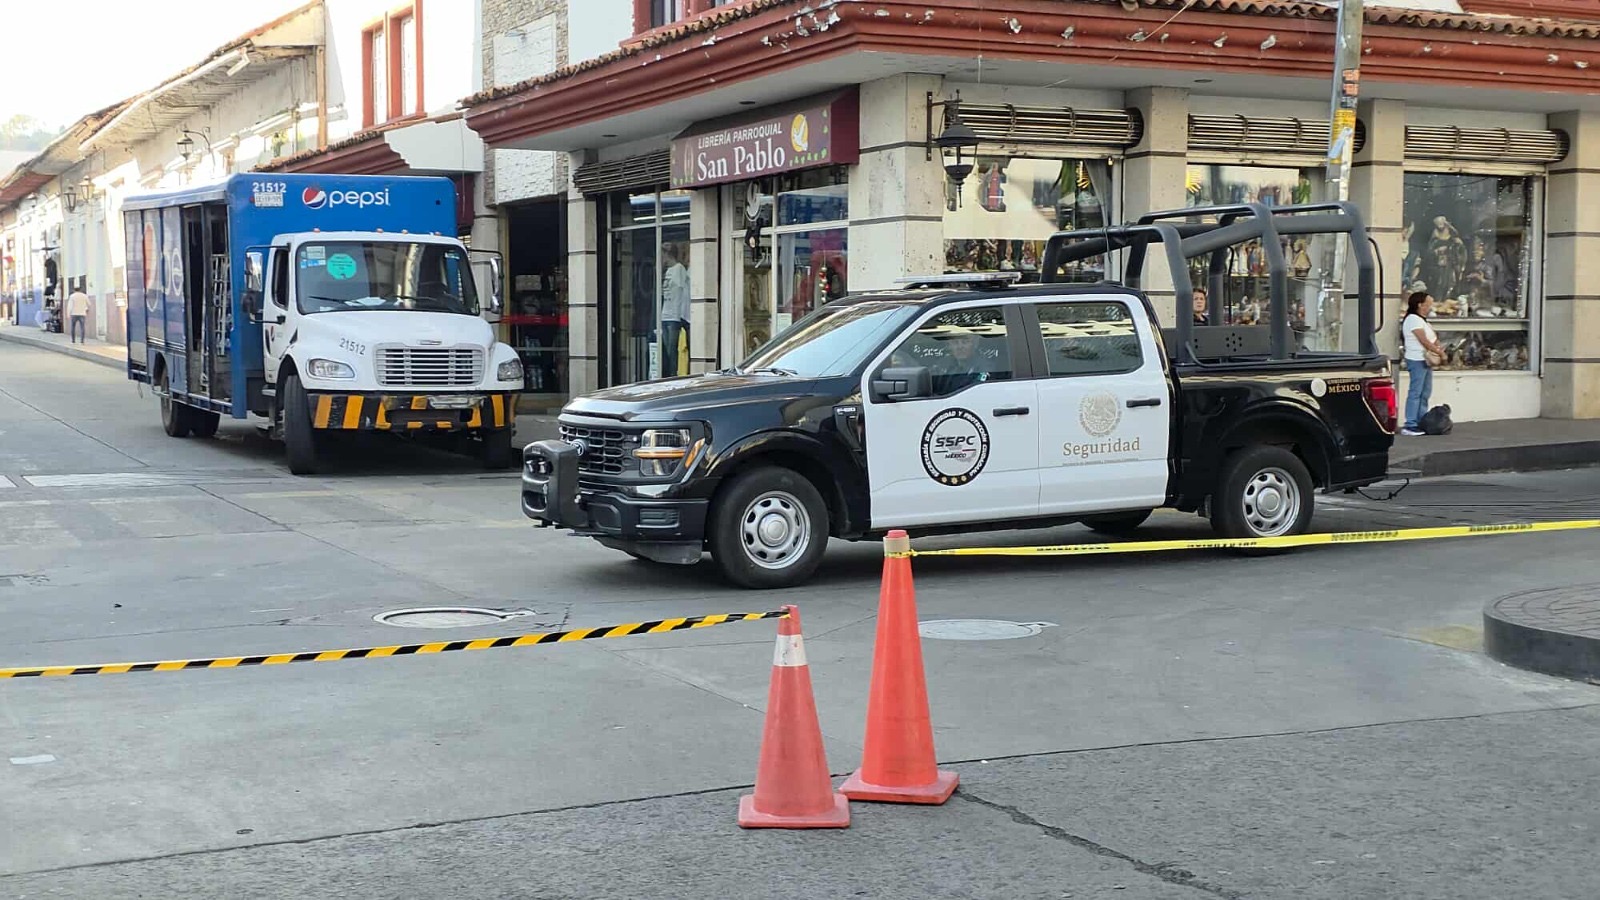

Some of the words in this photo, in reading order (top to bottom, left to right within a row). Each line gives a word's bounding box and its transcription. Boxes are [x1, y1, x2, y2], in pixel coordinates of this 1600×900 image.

[698, 132, 731, 149] LIBRERÍA
[733, 123, 782, 142] PARROQUIAL
[697, 152, 728, 181] San
[733, 138, 785, 176] Pablo
[252, 182, 287, 193] 21512
[329, 188, 390, 208] pepsi
[339, 338, 366, 355] 21512
[1328, 384, 1361, 393] MÉXICO
[935, 435, 976, 447] SSPC
[1063, 437, 1140, 459] Seguridad
